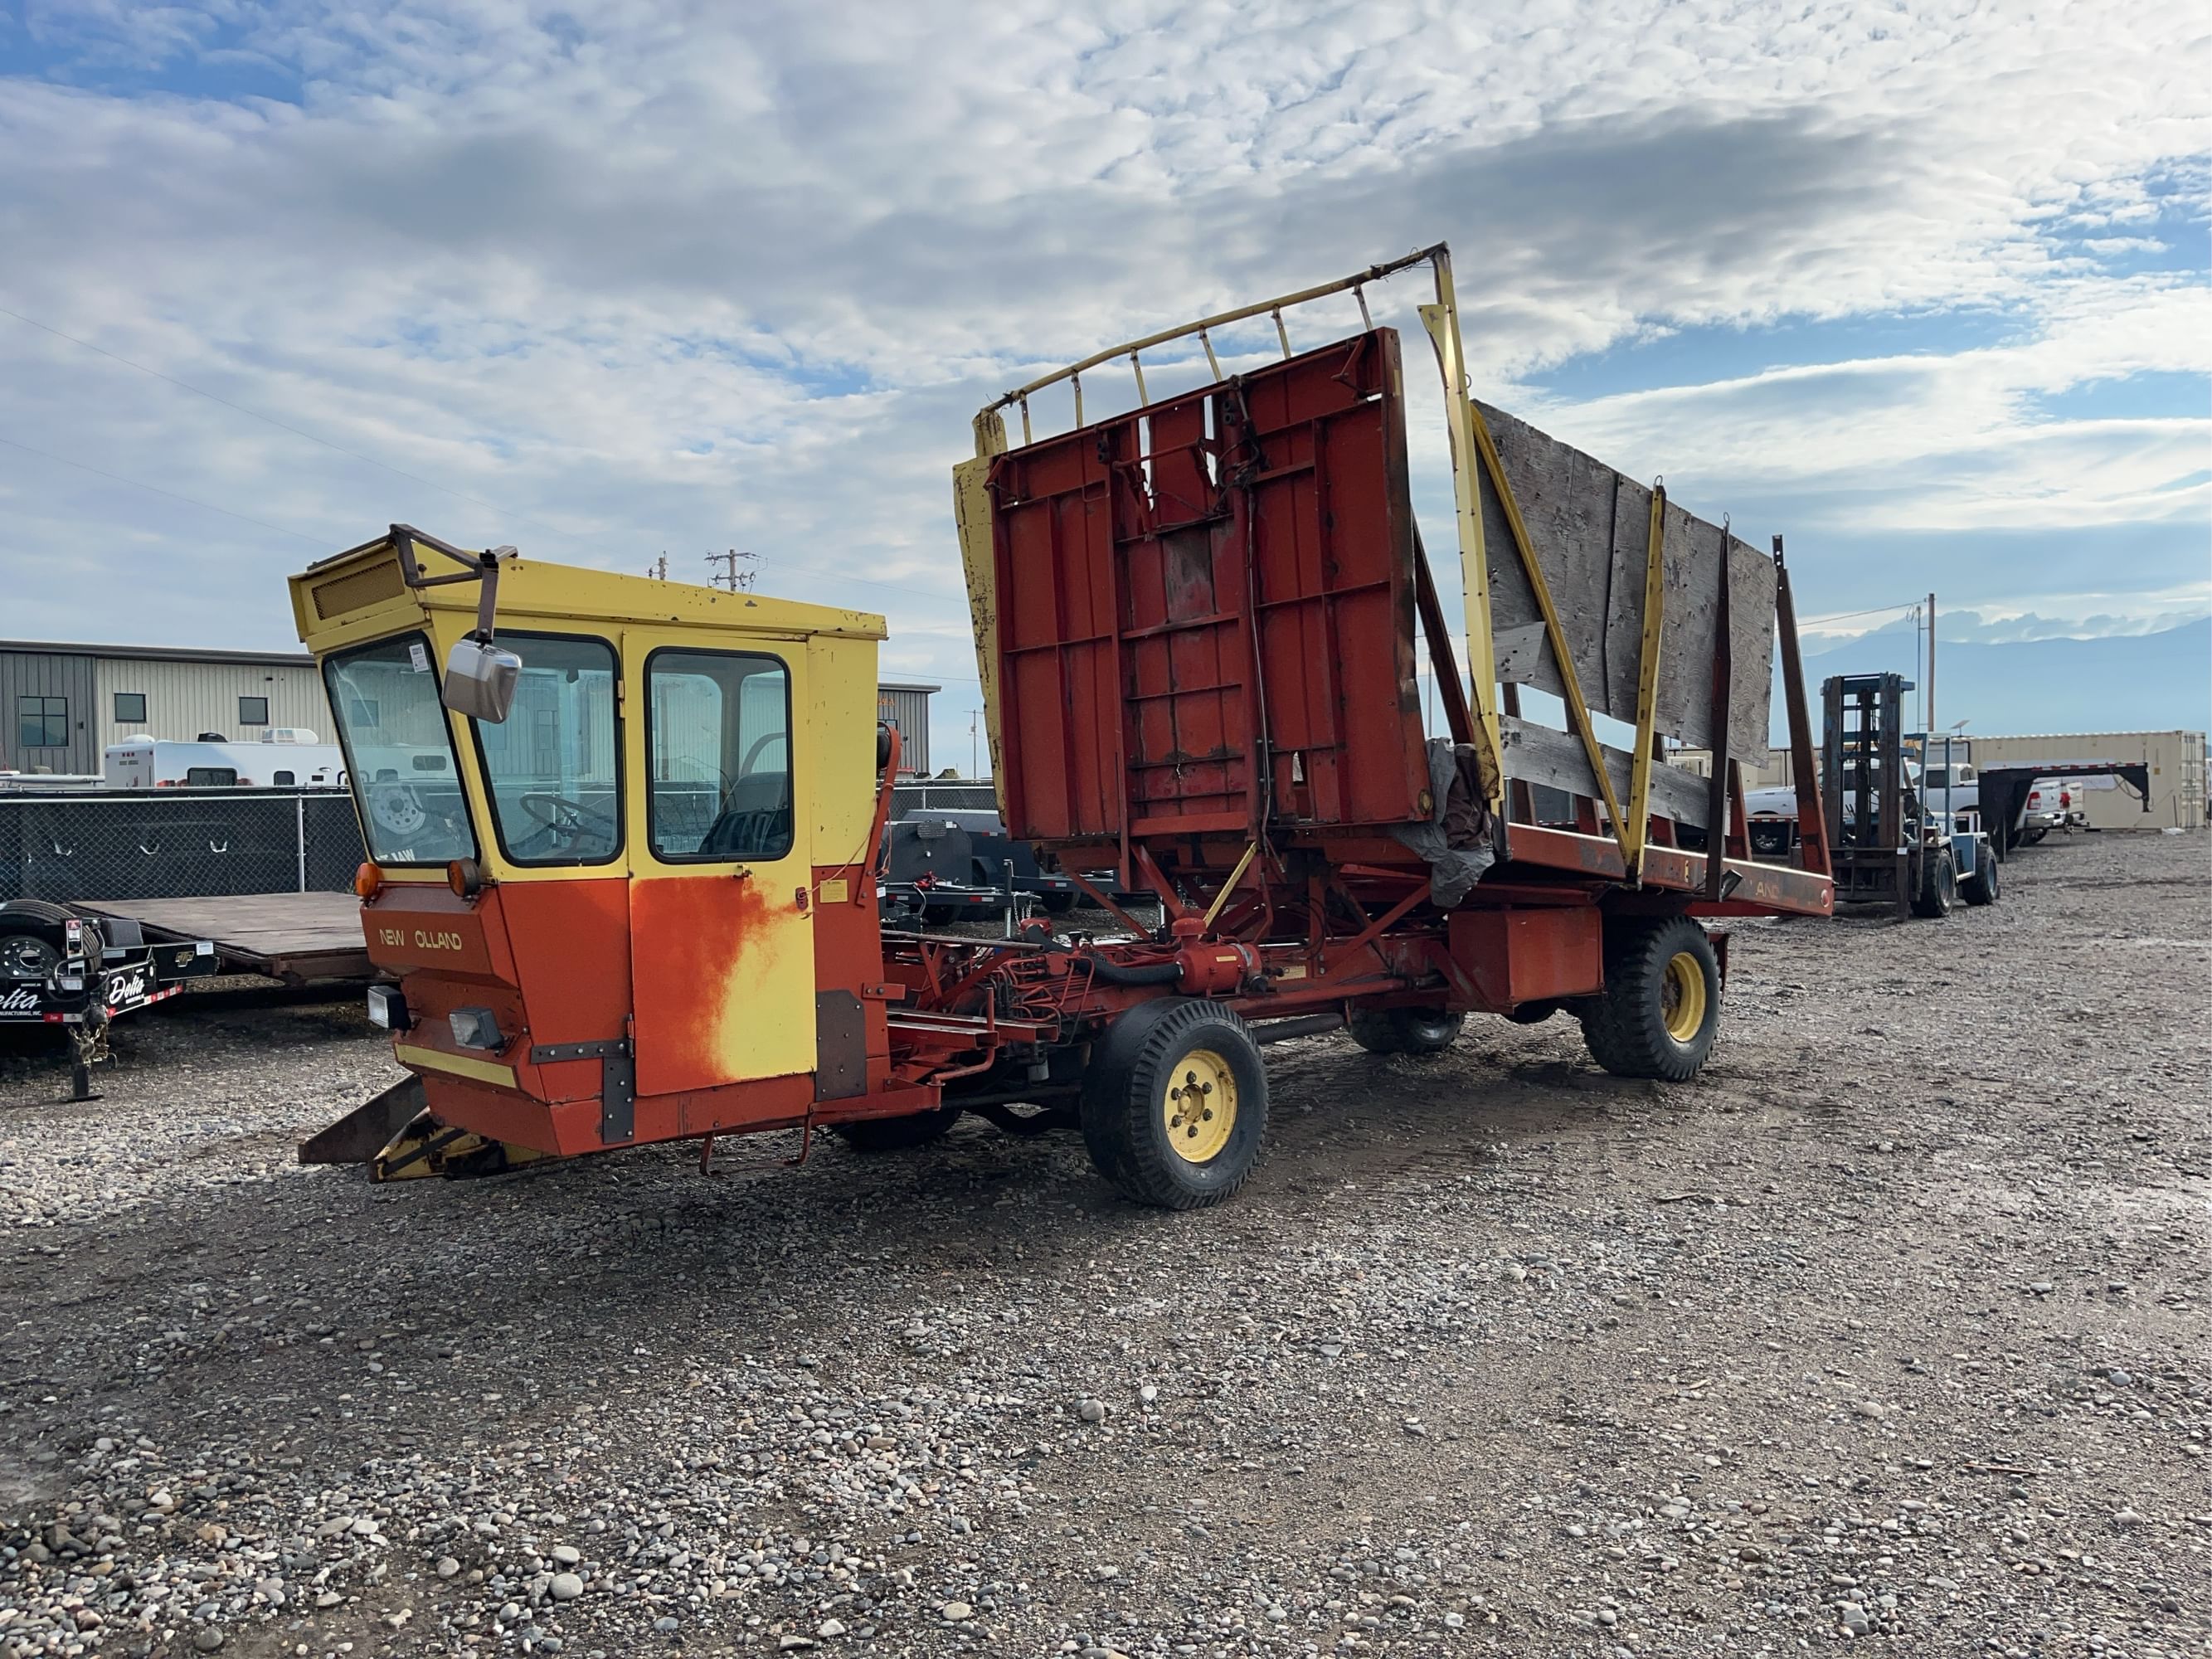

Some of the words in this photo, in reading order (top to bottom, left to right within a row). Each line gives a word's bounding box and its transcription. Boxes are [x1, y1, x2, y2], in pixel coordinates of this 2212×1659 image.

[379, 928, 405, 946] NEW
[415, 930, 462, 951] OLLAND
[0, 988, 41, 1010] elta
[109, 974, 145, 1005] Delta
